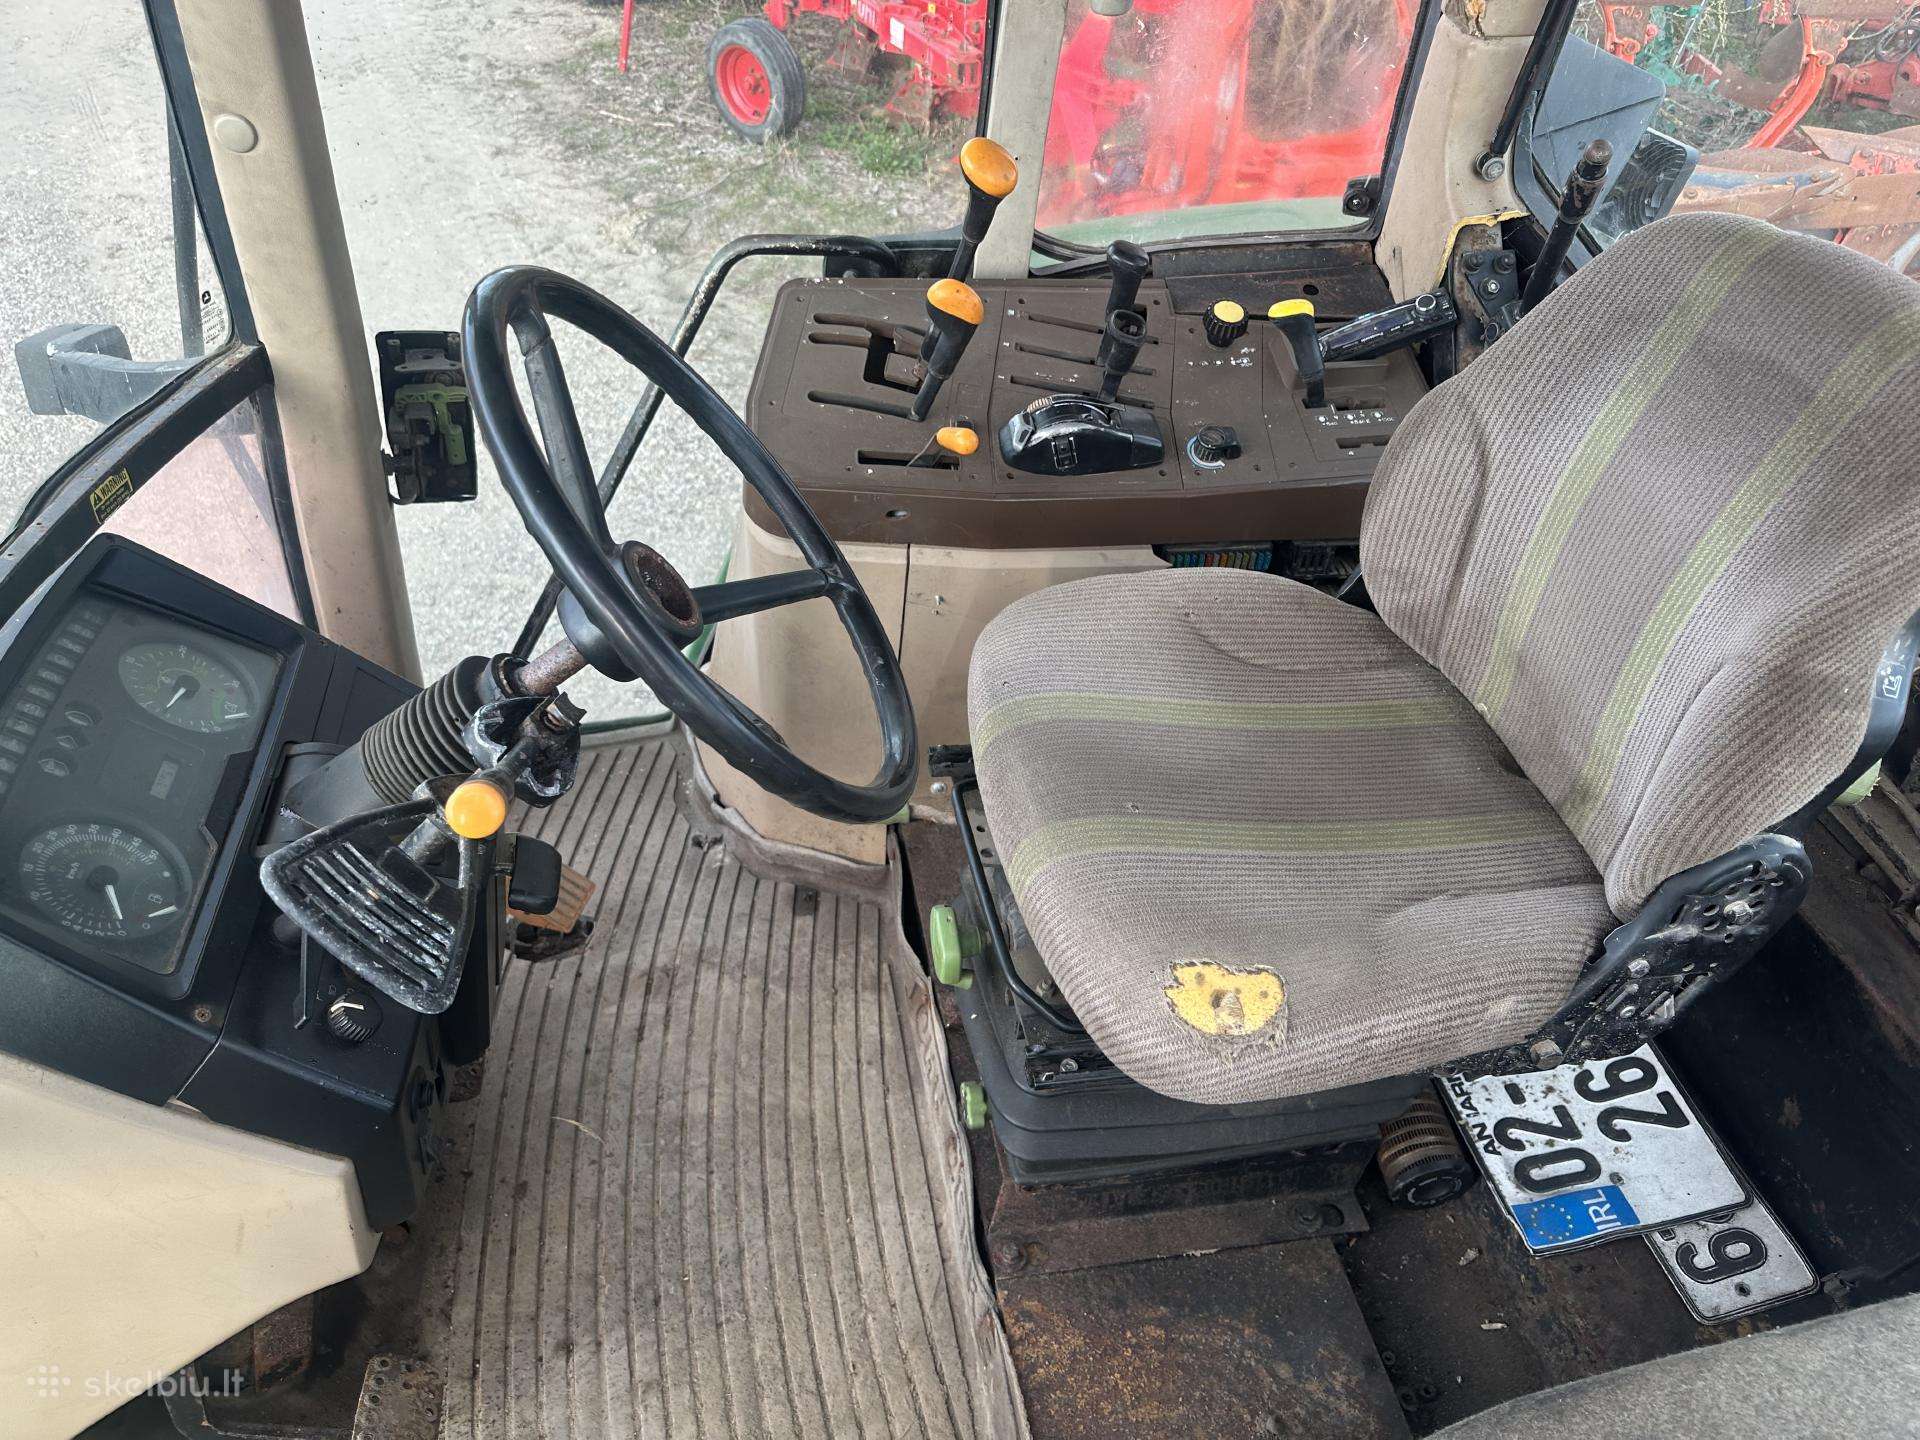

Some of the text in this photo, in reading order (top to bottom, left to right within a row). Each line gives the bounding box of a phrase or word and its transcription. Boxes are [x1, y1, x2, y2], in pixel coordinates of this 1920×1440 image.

[111, 828, 122, 840] 40
[23, 862, 34, 872] 15
[1574, 1056, 1690, 1143] 26
[1474, 1122, 1502, 1156] AN
[1582, 1188, 1618, 1232] IRL
[1658, 1212, 1768, 1284] 6
